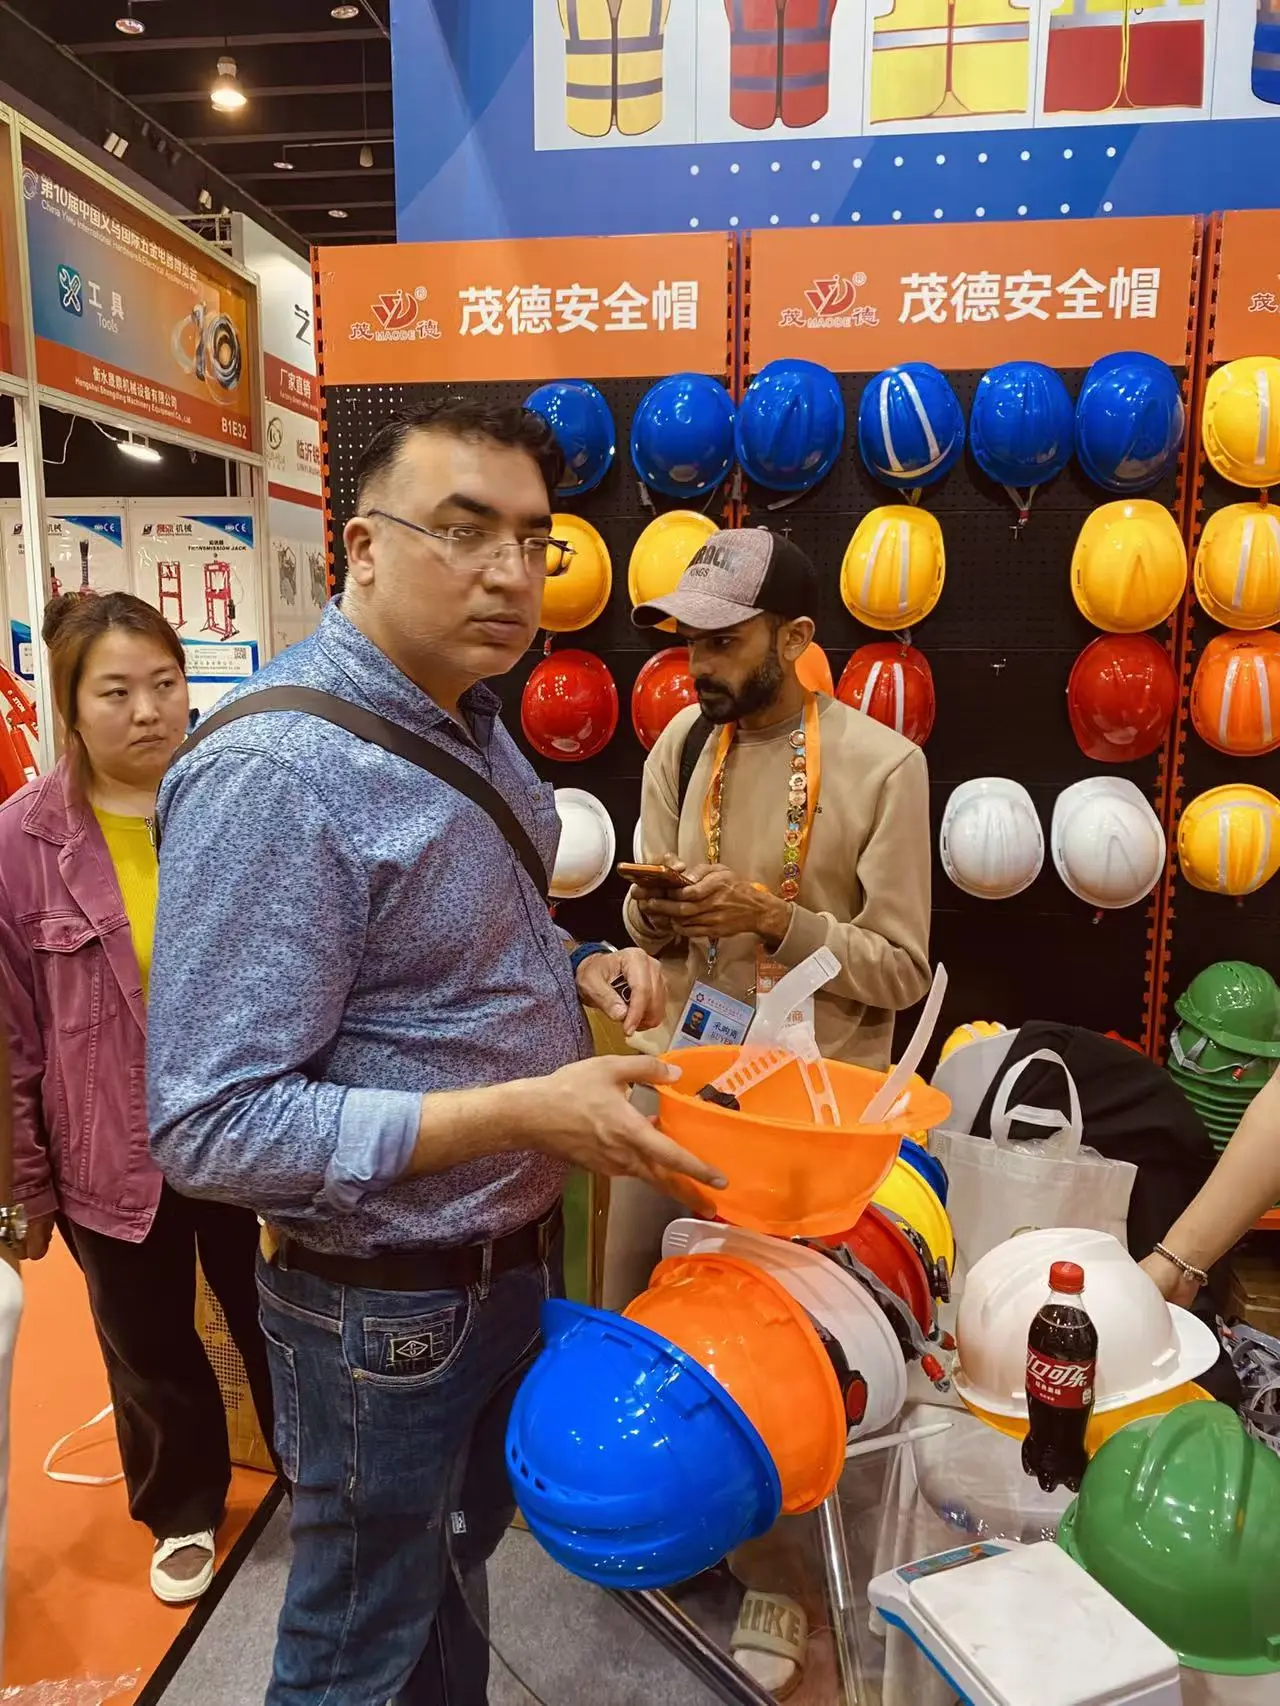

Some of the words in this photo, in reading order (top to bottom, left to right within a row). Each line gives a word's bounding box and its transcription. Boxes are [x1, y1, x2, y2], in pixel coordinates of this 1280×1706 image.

[41, 200, 61, 217] China
[88, 280, 124, 320] 工具
[458, 280, 699, 336] 茂德安全帽
[897, 266, 1161, 324] 茂德安全帽
[96, 311, 119, 333] Tools
[280, 367, 311, 399] 厂家直销
[221, 417, 247, 440] B1E32
